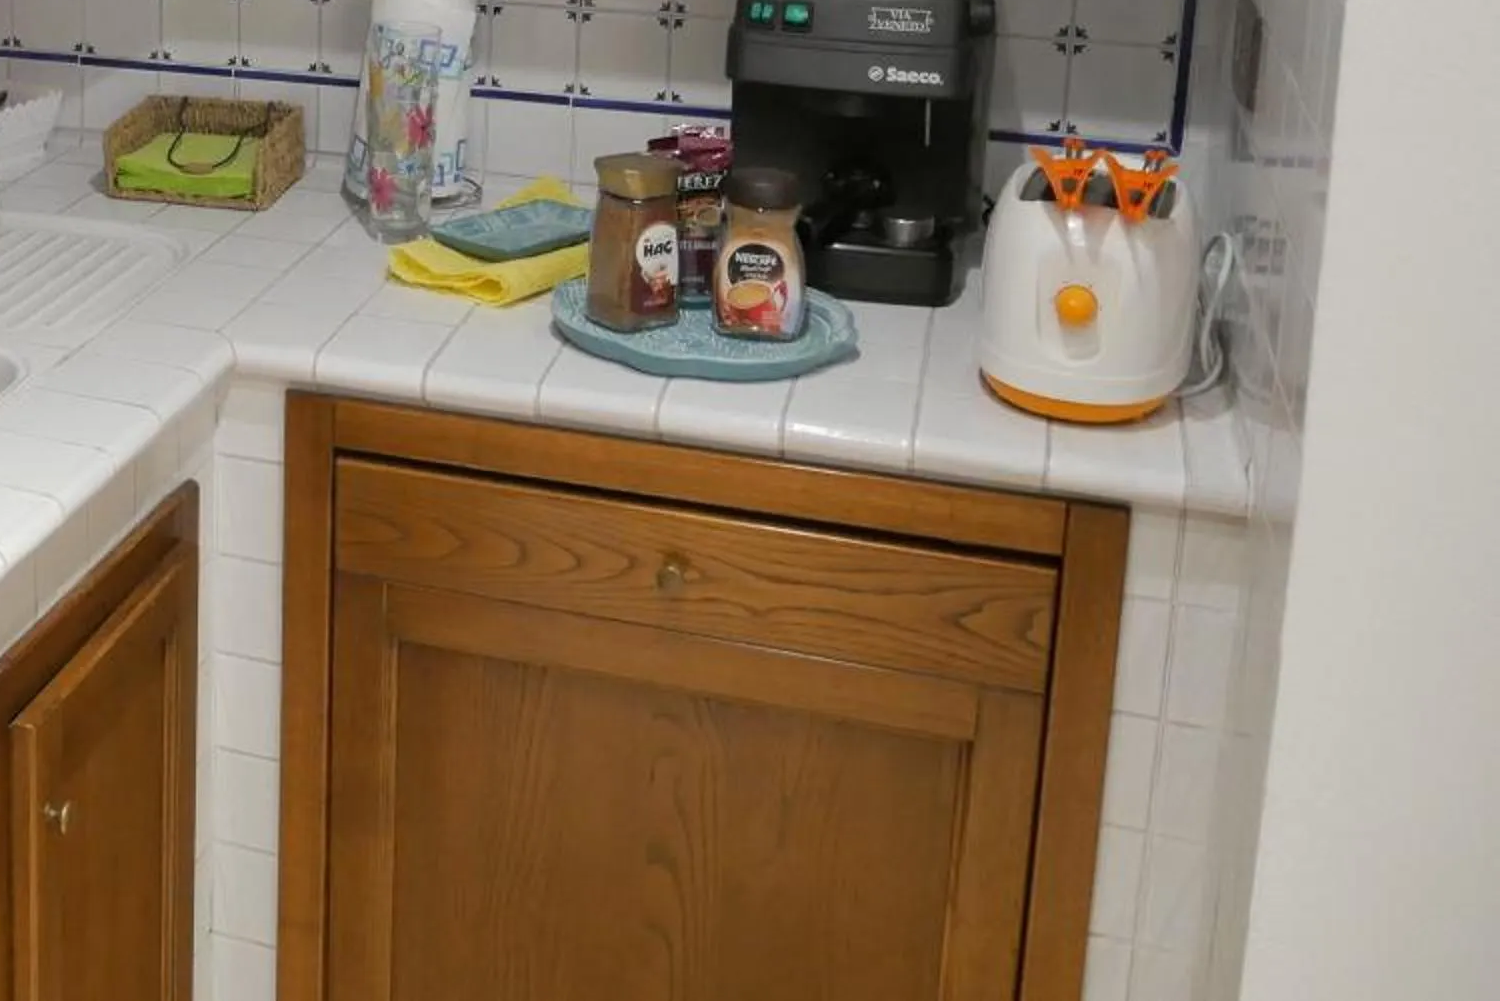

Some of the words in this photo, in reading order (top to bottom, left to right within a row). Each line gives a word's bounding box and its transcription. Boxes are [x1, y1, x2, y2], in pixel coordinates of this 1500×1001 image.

[890, 9, 912, 20] VIA
[886, 66, 942, 85] Saeco
[643, 239, 674, 258] HAG
